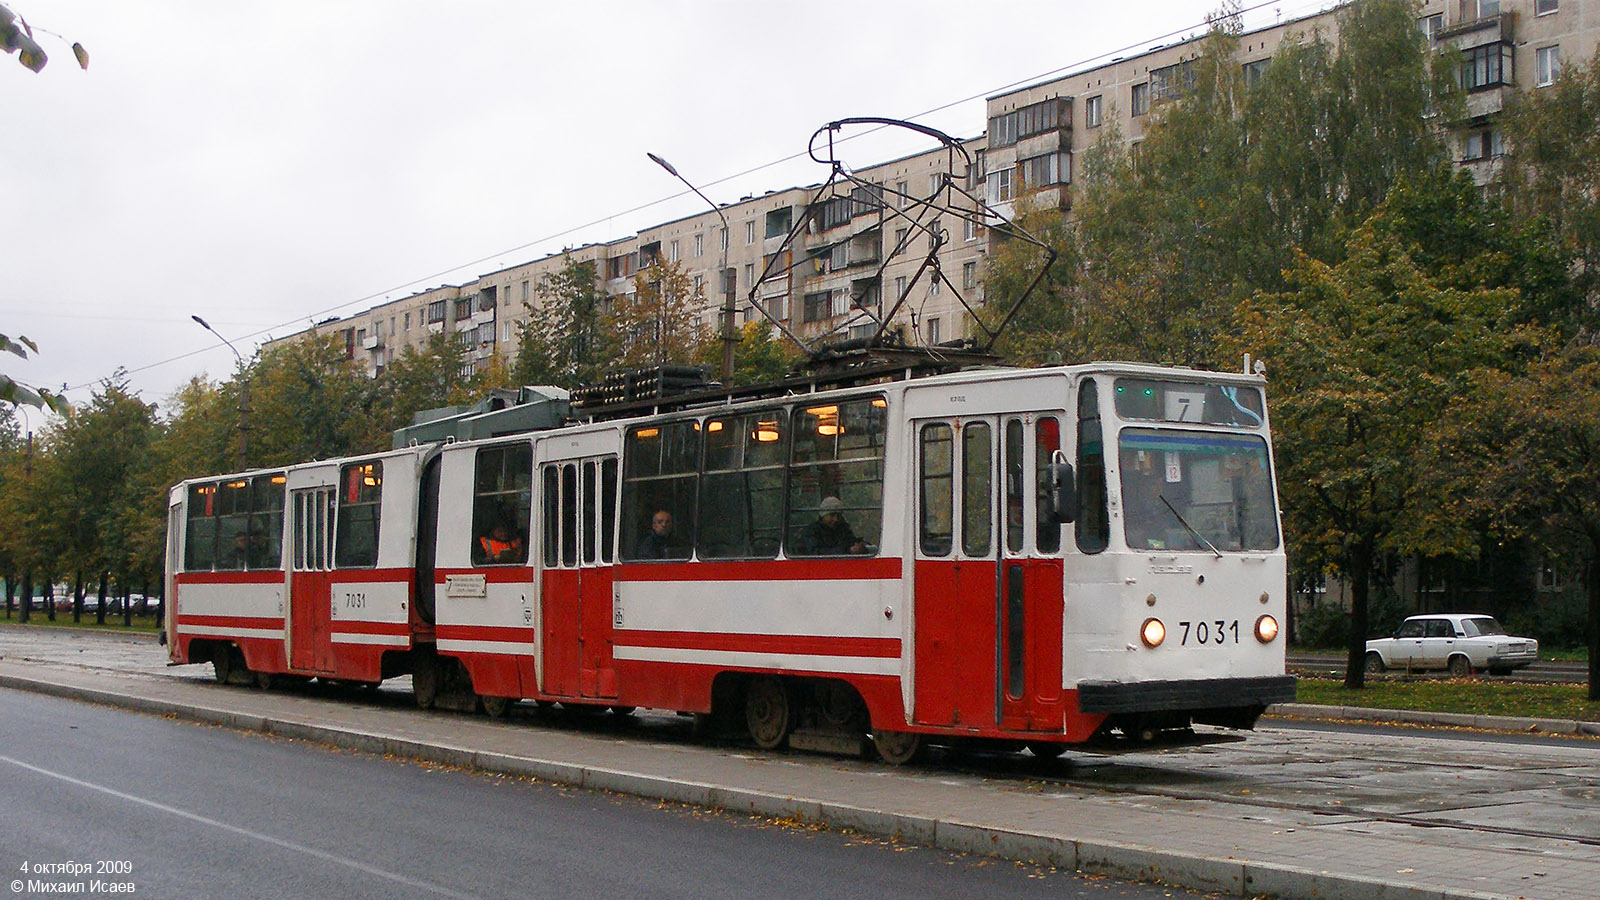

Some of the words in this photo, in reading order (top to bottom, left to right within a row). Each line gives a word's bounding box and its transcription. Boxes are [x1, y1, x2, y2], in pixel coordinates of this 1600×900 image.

[1178, 398, 1190, 421] 7
[345, 593, 366, 608] 7031
[1179, 619, 1239, 646] 7031
